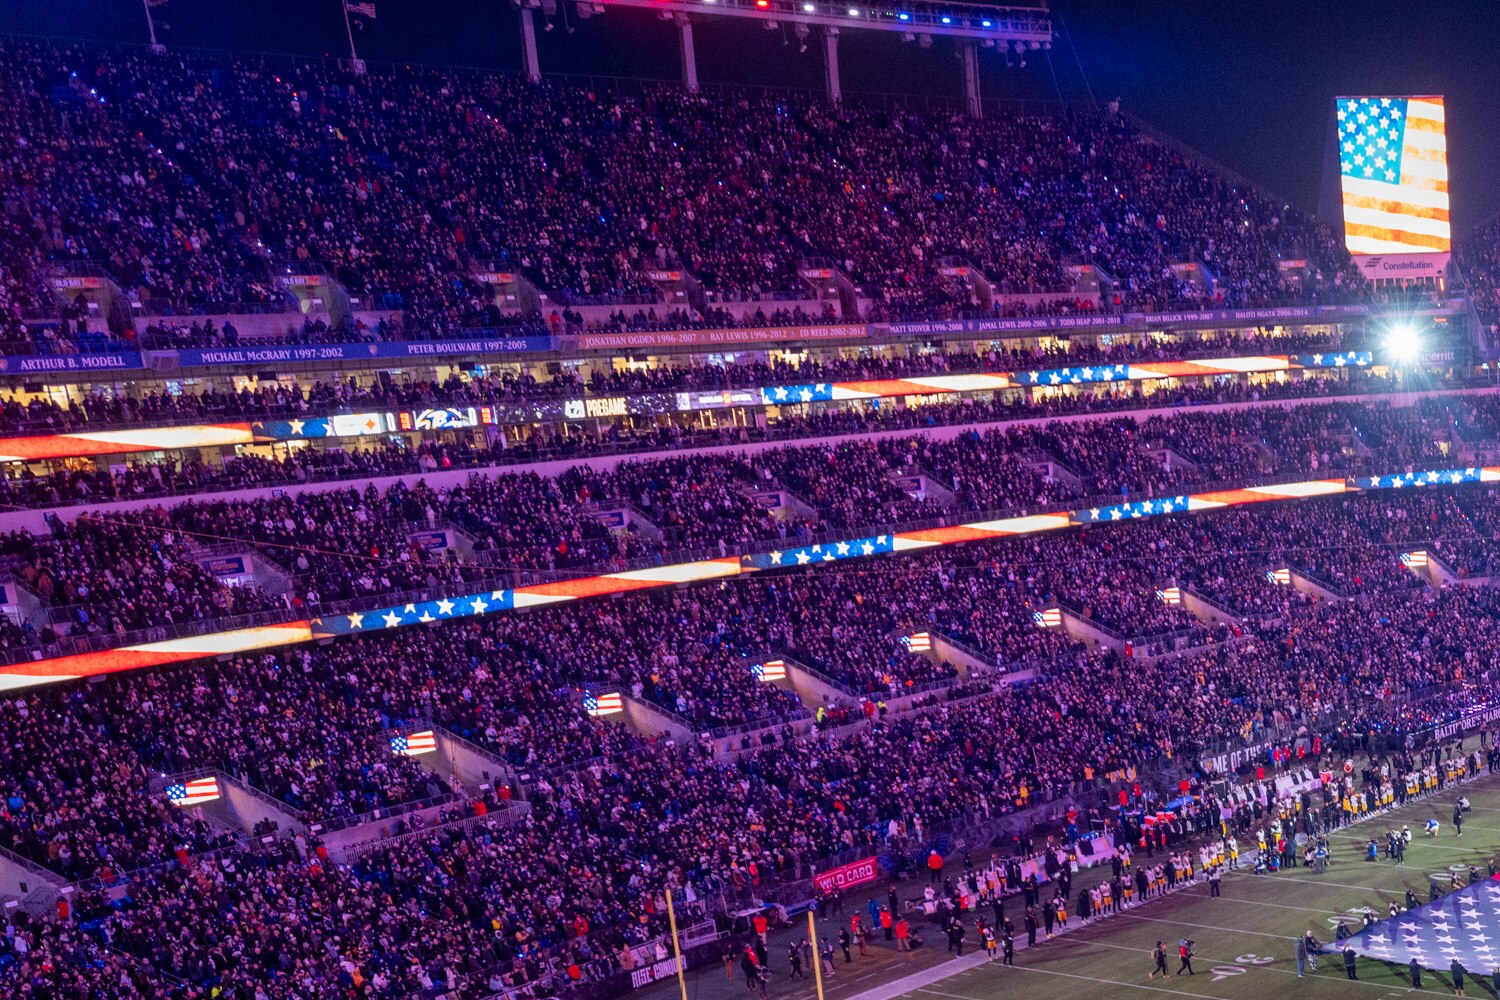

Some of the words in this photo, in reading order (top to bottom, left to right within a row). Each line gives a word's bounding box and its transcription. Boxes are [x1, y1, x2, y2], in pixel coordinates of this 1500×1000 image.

[1383, 261, 1433, 270] Constellation
[800, 329, 809, 338] ED
[811, 328, 829, 338] REED
[890, 325, 906, 334] MATT
[907, 324, 930, 333] STOVER
[980, 322, 998, 331] JAMAL
[999, 321, 1016, 330] LEWIS
[585, 336, 627, 348] JONATHAN
[628, 335, 655, 346] OGDEN
[657, 333, 697, 344] 1996-2007
[710, 332, 724, 342] RAY
[726, 331, 748, 341] LEWIS
[750, 330, 787, 340] 1996-2012
[408, 344, 434, 354] PETER
[436, 342, 482, 353] BOULWARE
[484, 340, 527, 351] 1997-2005
[201, 352, 245, 363] MICHAEL
[247, 350, 291, 361] McCRARY
[294, 347, 343, 359] 1997-2002
[21, 359, 66, 370] ARTHUR
[68, 359, 80, 369] B.
[82, 356, 126, 367] MODELL
[586, 398, 628, 417] PREGAME
[820, 874, 845, 889] WILD
[846, 865, 873, 881] CARD
[632, 967, 650, 988] RISE
[653, 955, 688, 981] CONQUR
